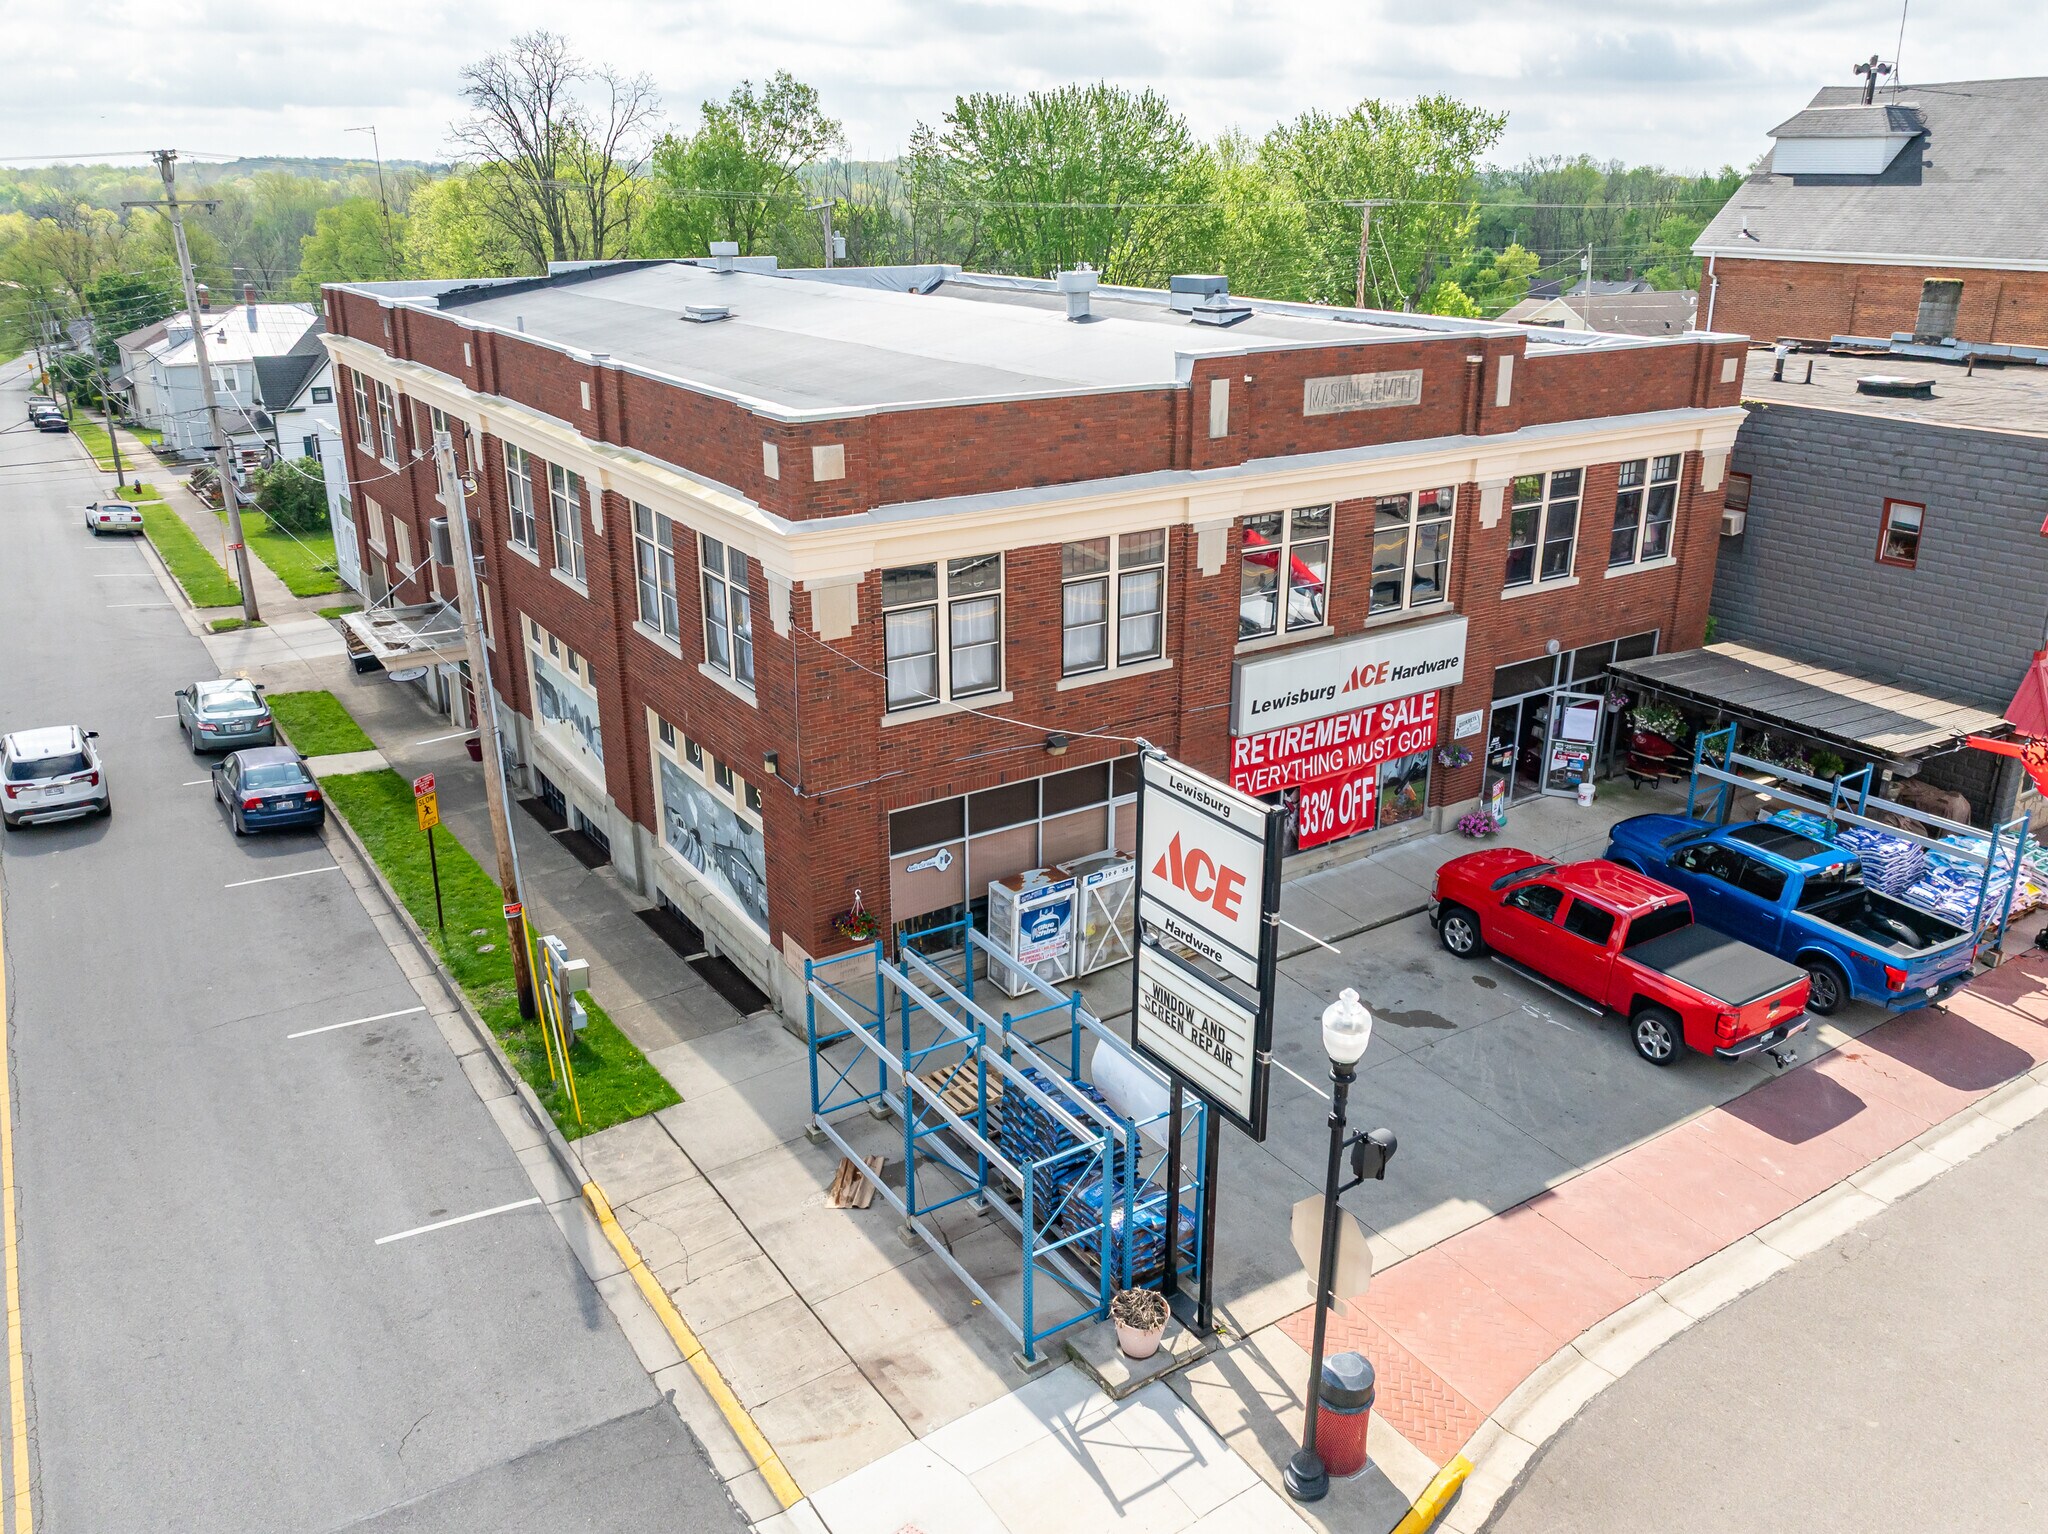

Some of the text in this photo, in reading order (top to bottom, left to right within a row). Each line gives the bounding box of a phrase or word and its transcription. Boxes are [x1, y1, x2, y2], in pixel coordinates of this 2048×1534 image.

[1251, 655, 1459, 715] Lewisburg ACE Hardware
[1234, 691, 1436, 769] RETIREMENT SALE
[1235, 731, 1343, 795] EVERYTHING
[1347, 738, 1392, 767] MUST
[1398, 725, 1432, 754] GO!!
[418, 795, 435, 807] SLOW
[1169, 775, 1232, 818] Lewisburg
[1300, 776, 1374, 837] 33% OFF
[1151, 830, 1247, 922] ACE
[1165, 917, 1223, 963] Hardware
[1144, 994, 1234, 1068] SCREEN REPAIR
[1152, 982, 1226, 1045] WINDOW AND
